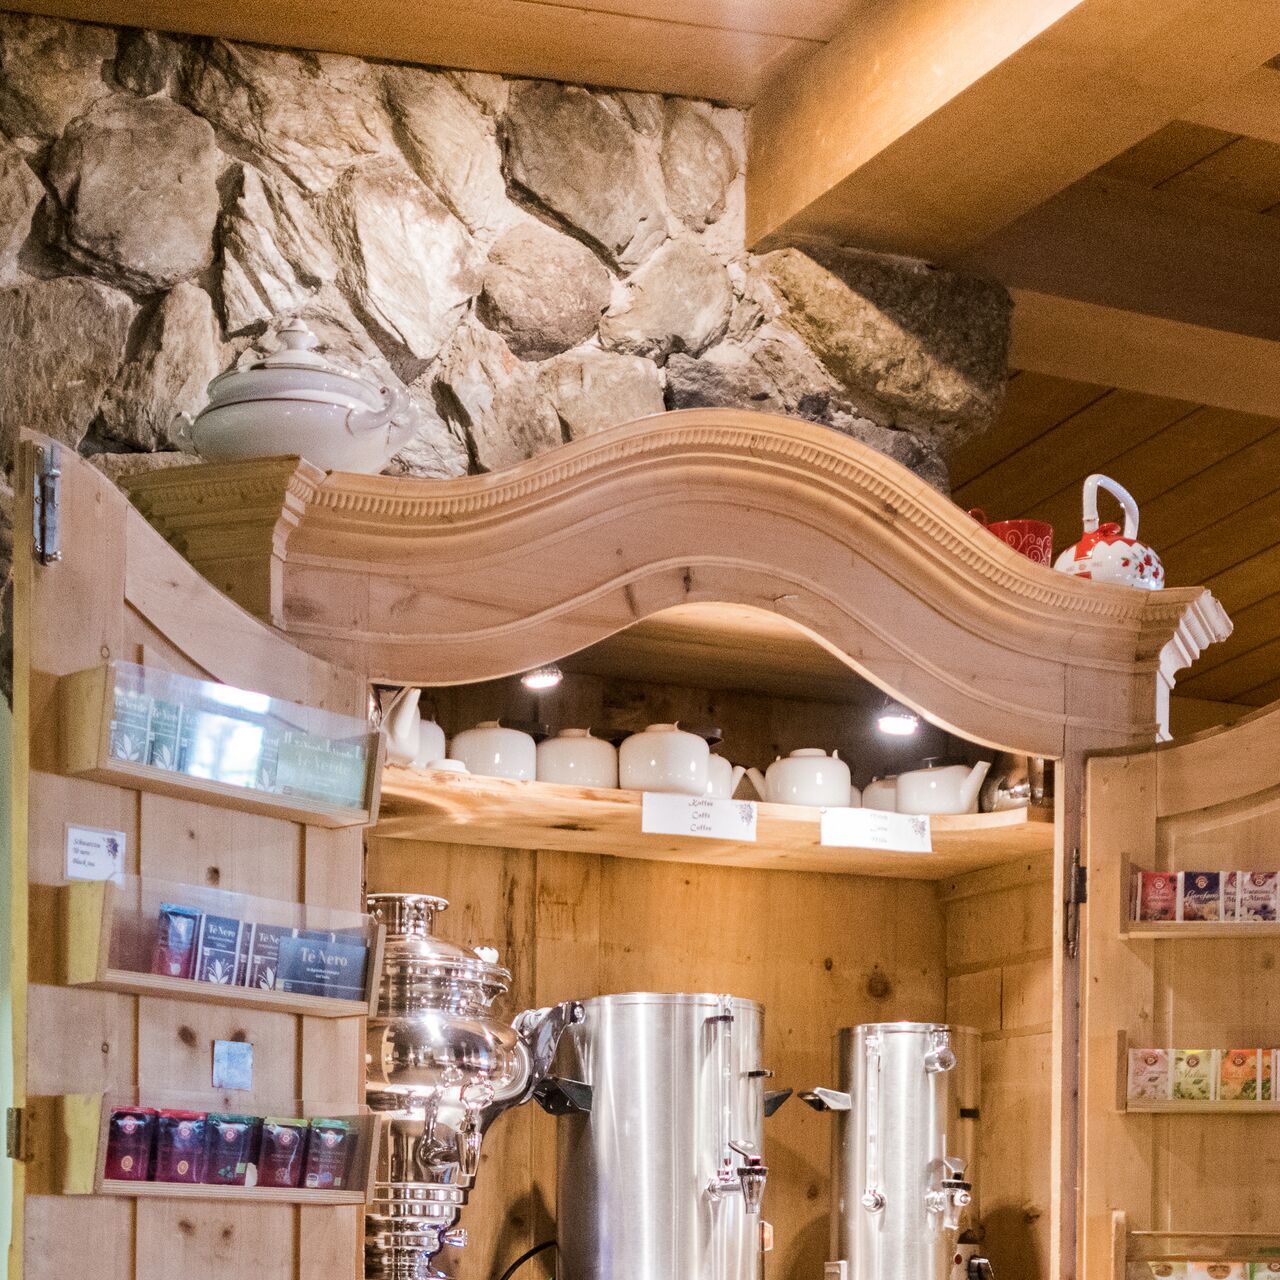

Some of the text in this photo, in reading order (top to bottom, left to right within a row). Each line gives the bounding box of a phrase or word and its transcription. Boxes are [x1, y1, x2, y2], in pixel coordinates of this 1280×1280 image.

[218, 925, 236, 938] Nero
[301, 946, 348, 967] Tè Nero
